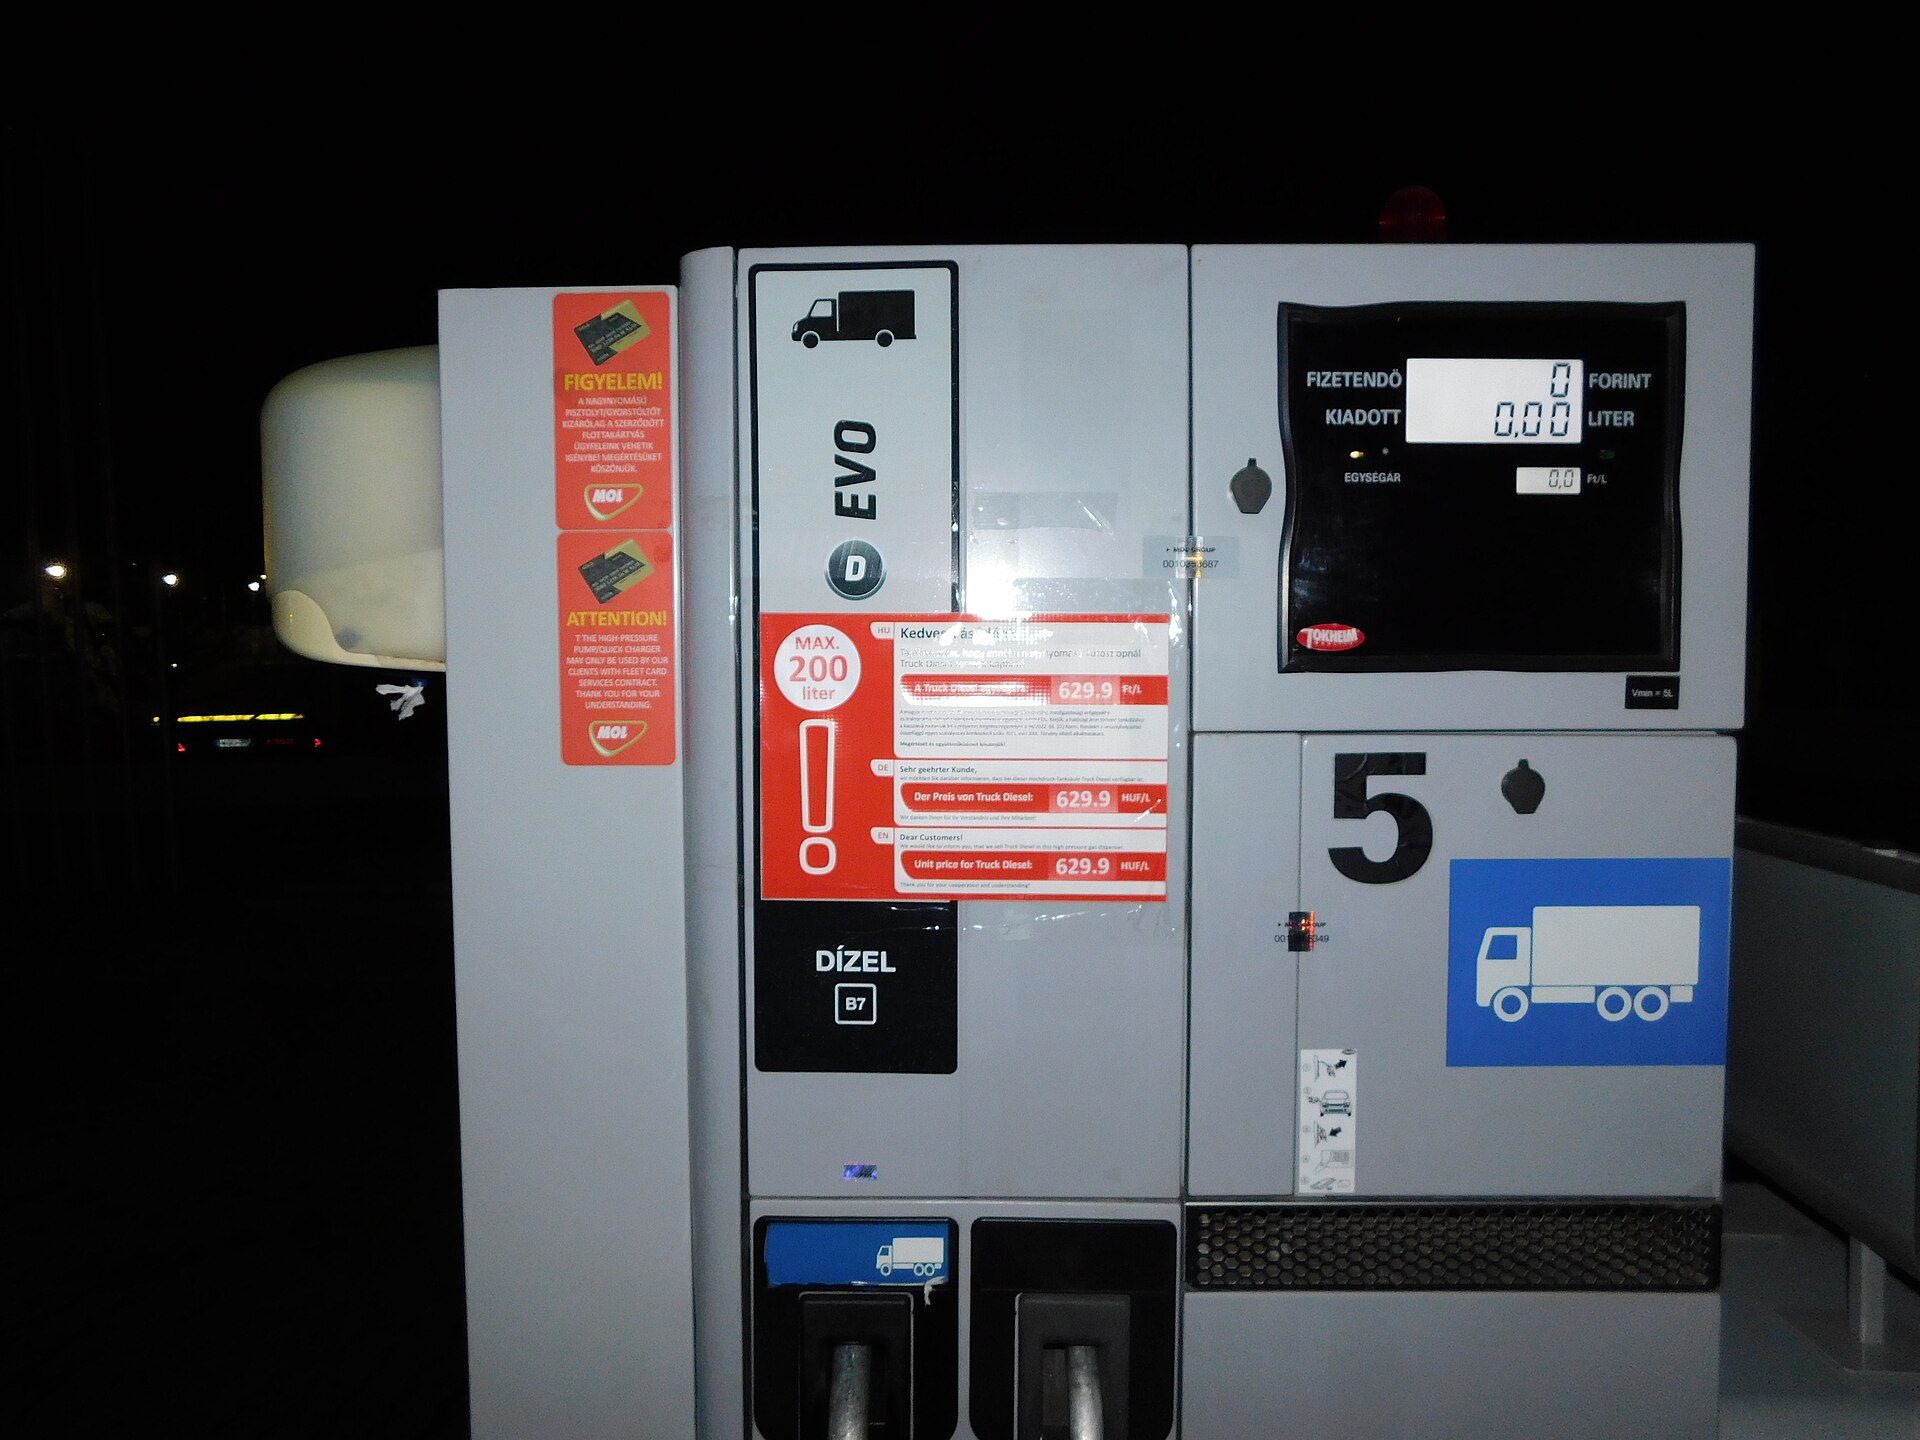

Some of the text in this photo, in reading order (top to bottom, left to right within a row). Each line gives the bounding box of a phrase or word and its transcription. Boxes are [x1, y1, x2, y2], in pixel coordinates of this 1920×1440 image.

[564, 371, 663, 391] FIGYELEM!
[1550, 361, 1571, 397] 0
[1589, 373, 1652, 389] FORINT
[1326, 409, 1402, 425] KIADOTT
[1588, 411, 1635, 427] LITER
[834, 419, 877, 520] EVO
[592, 488, 623, 503] MOL
[845, 555, 866, 582] D
[567, 610, 667, 627] ATTENTION!
[878, 626, 890, 634] HU
[582, 634, 597, 642] THE
[795, 636, 840, 650] MAX.
[1299, 628, 1359, 650] TOKHEIM
[624, 645, 661, 654] CHARGER
[566, 656, 584, 665] MAY
[607, 656, 618, 664] BE
[618, 656, 639, 665] USED
[640, 656, 650, 664] BY
[651, 656, 669, 665] OUR
[568, 667, 667, 676] CLIENTS WITH FLEET CARD
[789, 655, 848, 682] 200
[578, 678, 613, 687] SERVICES
[1122, 684, 1142, 695] Ft/L
[575, 689, 660, 698] THANK YOU FOR YOUR
[802, 686, 836, 700] liter
[1059, 682, 1113, 699] 629.9
[1632, 688, 1653, 697] Vmin
[597, 726, 628, 740] MOL
[878, 763, 889, 772] DE
[918, 766, 950, 775] geehrter
[952, 766, 978, 774] Kunde,
[914, 792, 1034, 802] Der Preis von Truck Diesel:
[1056, 790, 1111, 808] 629.9
[1122, 792, 1151, 804] HUF/L
[1328, 751, 1433, 885] 5
[878, 832, 889, 840] EN
[920, 834, 964, 842] Customers!
[914, 860, 1033, 870] Unit price for Truck Diesel:
[1055, 857, 1110, 875] 629.9
[1120, 861, 1150, 872] HUF/L
[816, 944, 896, 972] DÍZEL
[845, 997, 866, 1011] B7
